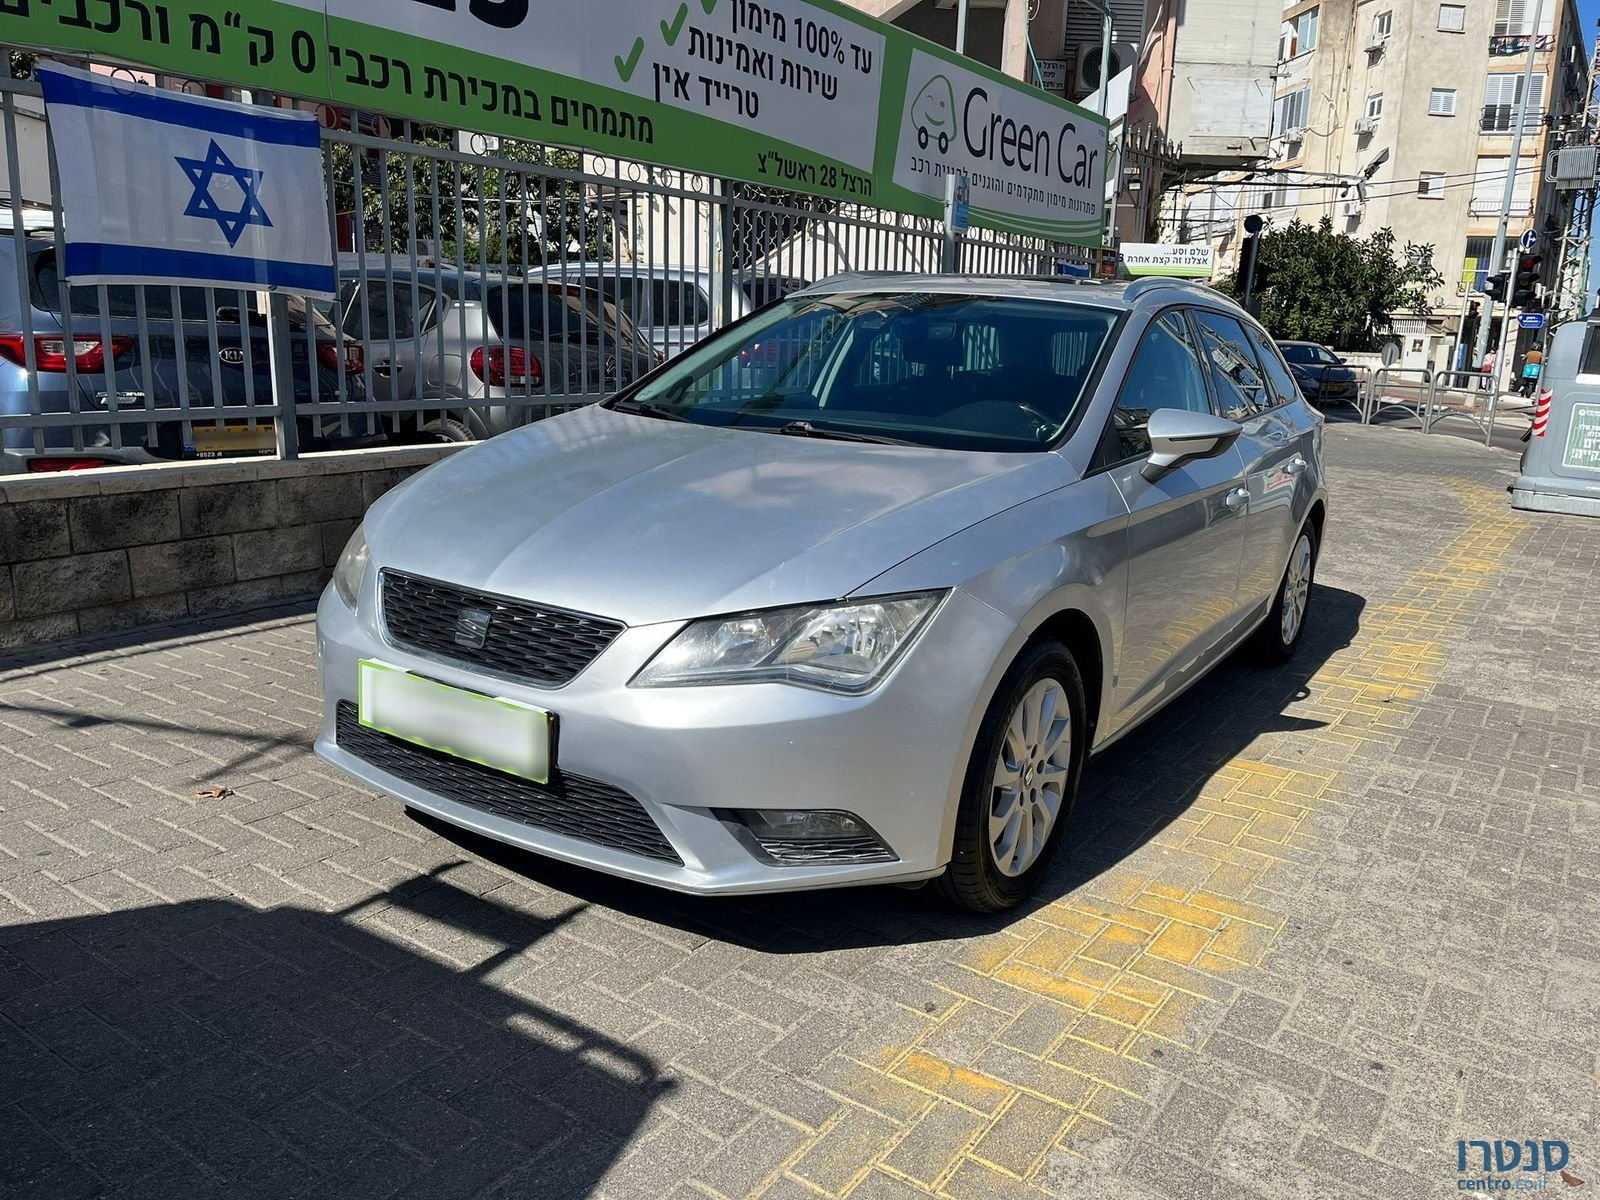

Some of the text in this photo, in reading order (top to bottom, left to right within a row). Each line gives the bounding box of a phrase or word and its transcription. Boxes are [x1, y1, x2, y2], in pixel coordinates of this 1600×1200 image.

[0, 0, 170, 45] ורכב
[732, 0, 872, 74] עד 100% מימון
[291, 30, 316, 74] 0
[687, 26, 838, 100] שירות ואמינות
[328, 45, 412, 95] רכבי
[424, 65, 542, 121] במכירת
[652, 62, 759, 119] טרייד אין
[551, 95, 653, 144] מתמחים
[963, 87, 1098, 190] Green Car
[757, 150, 872, 196] הרצל 28 ראשל"צ
[911, 156, 930, 175] רכב
[972, 173, 1004, 193] והוגנים
[1007, 182, 1044, 204] מתקדמים
[1047, 192, 1066, 208] מימון
[1068, 198, 1096, 215] פתרונות
[1126, 255, 1151, 263] אחרת
[1152, 255, 1170, 266] קצת
[1172, 256, 1182, 264] זה
[1184, 256, 1208, 265] אצלנו
[1190, 247, 1209, 256] שלם
